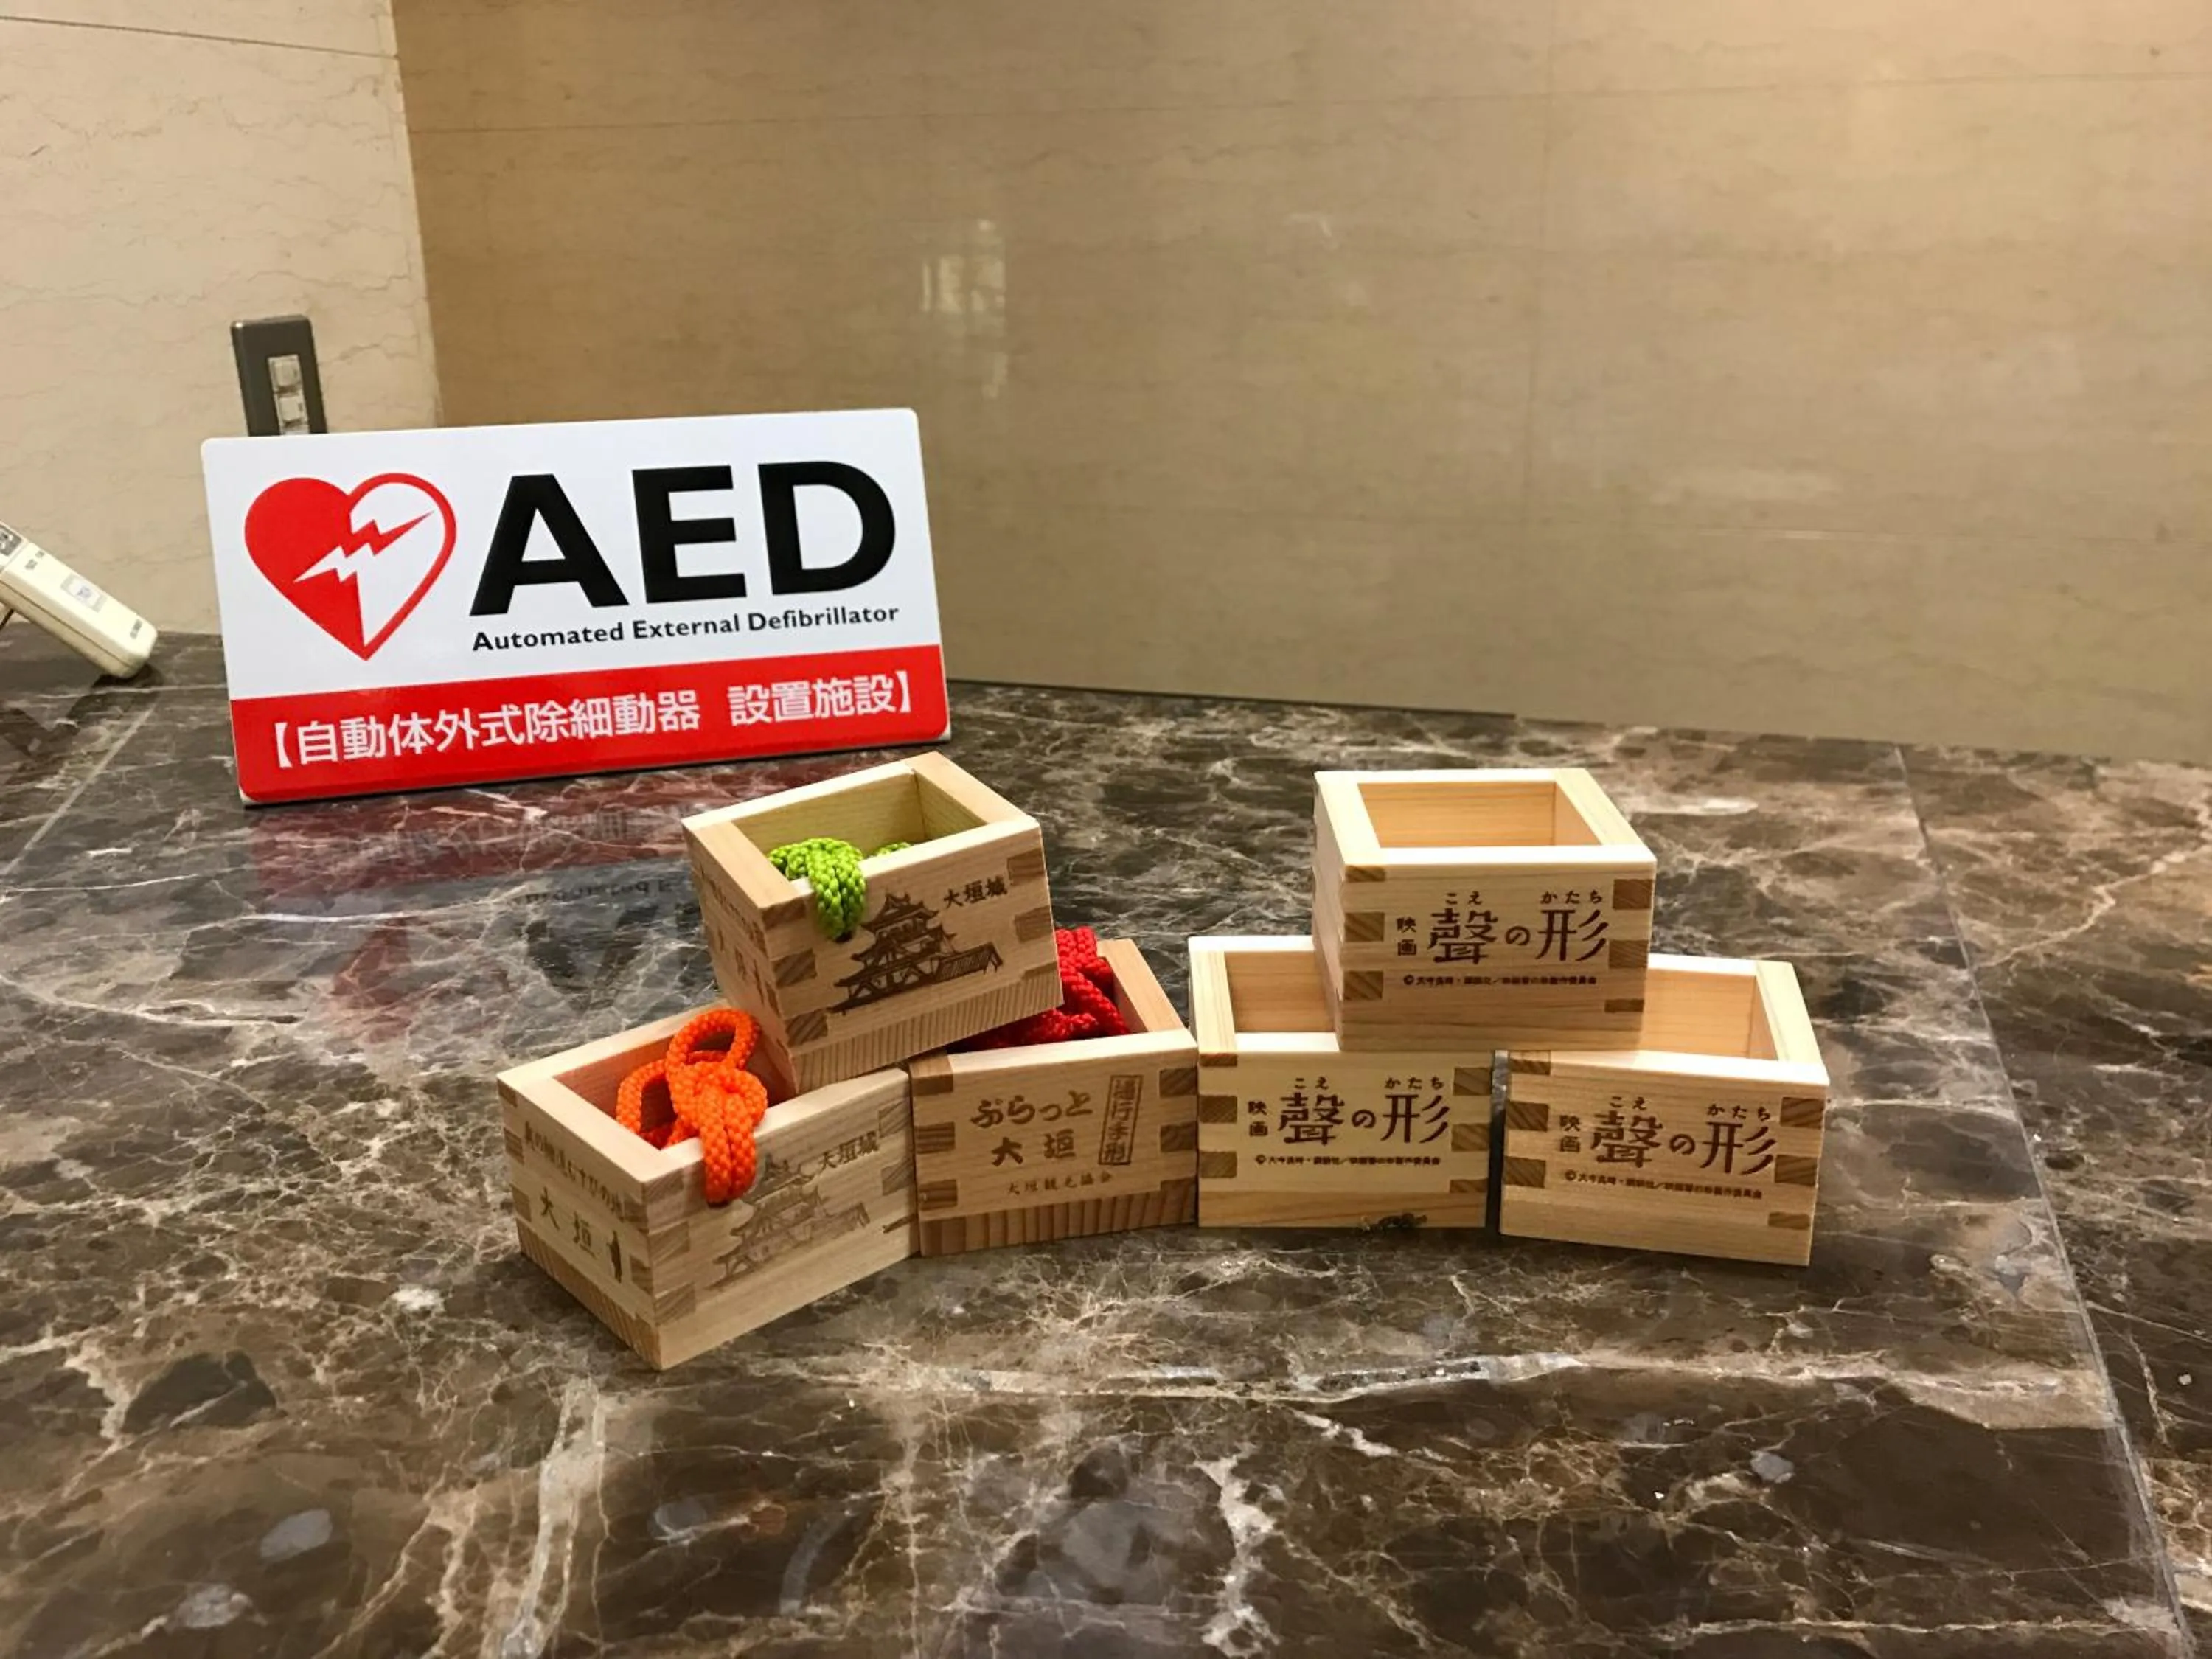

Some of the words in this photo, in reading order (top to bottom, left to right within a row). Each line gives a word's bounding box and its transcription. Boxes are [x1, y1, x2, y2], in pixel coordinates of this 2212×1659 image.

[470, 461, 896, 616] AED
[472, 621, 625, 653] Automated
[632, 614, 740, 640] External
[747, 606, 900, 633] Defibrillator
[942, 876, 1009, 908] 大垣城
[1444, 891, 1483, 905] こえ
[1541, 890, 1603, 904] かたち
[1427, 908, 1610, 964] 聲の形
[1295, 1077, 1329, 1090] こえ
[1384, 1077, 1445, 1090] かたち
[1278, 1092, 1451, 1146] 聲の形
[1610, 1096, 1647, 1110] こえ
[1707, 1103, 1771, 1121] かたち
[818, 1130, 882, 1171] 大垣城
[992, 1128, 1077, 1167] 大垣
[1590, 1110, 1777, 1176] 聲の形
